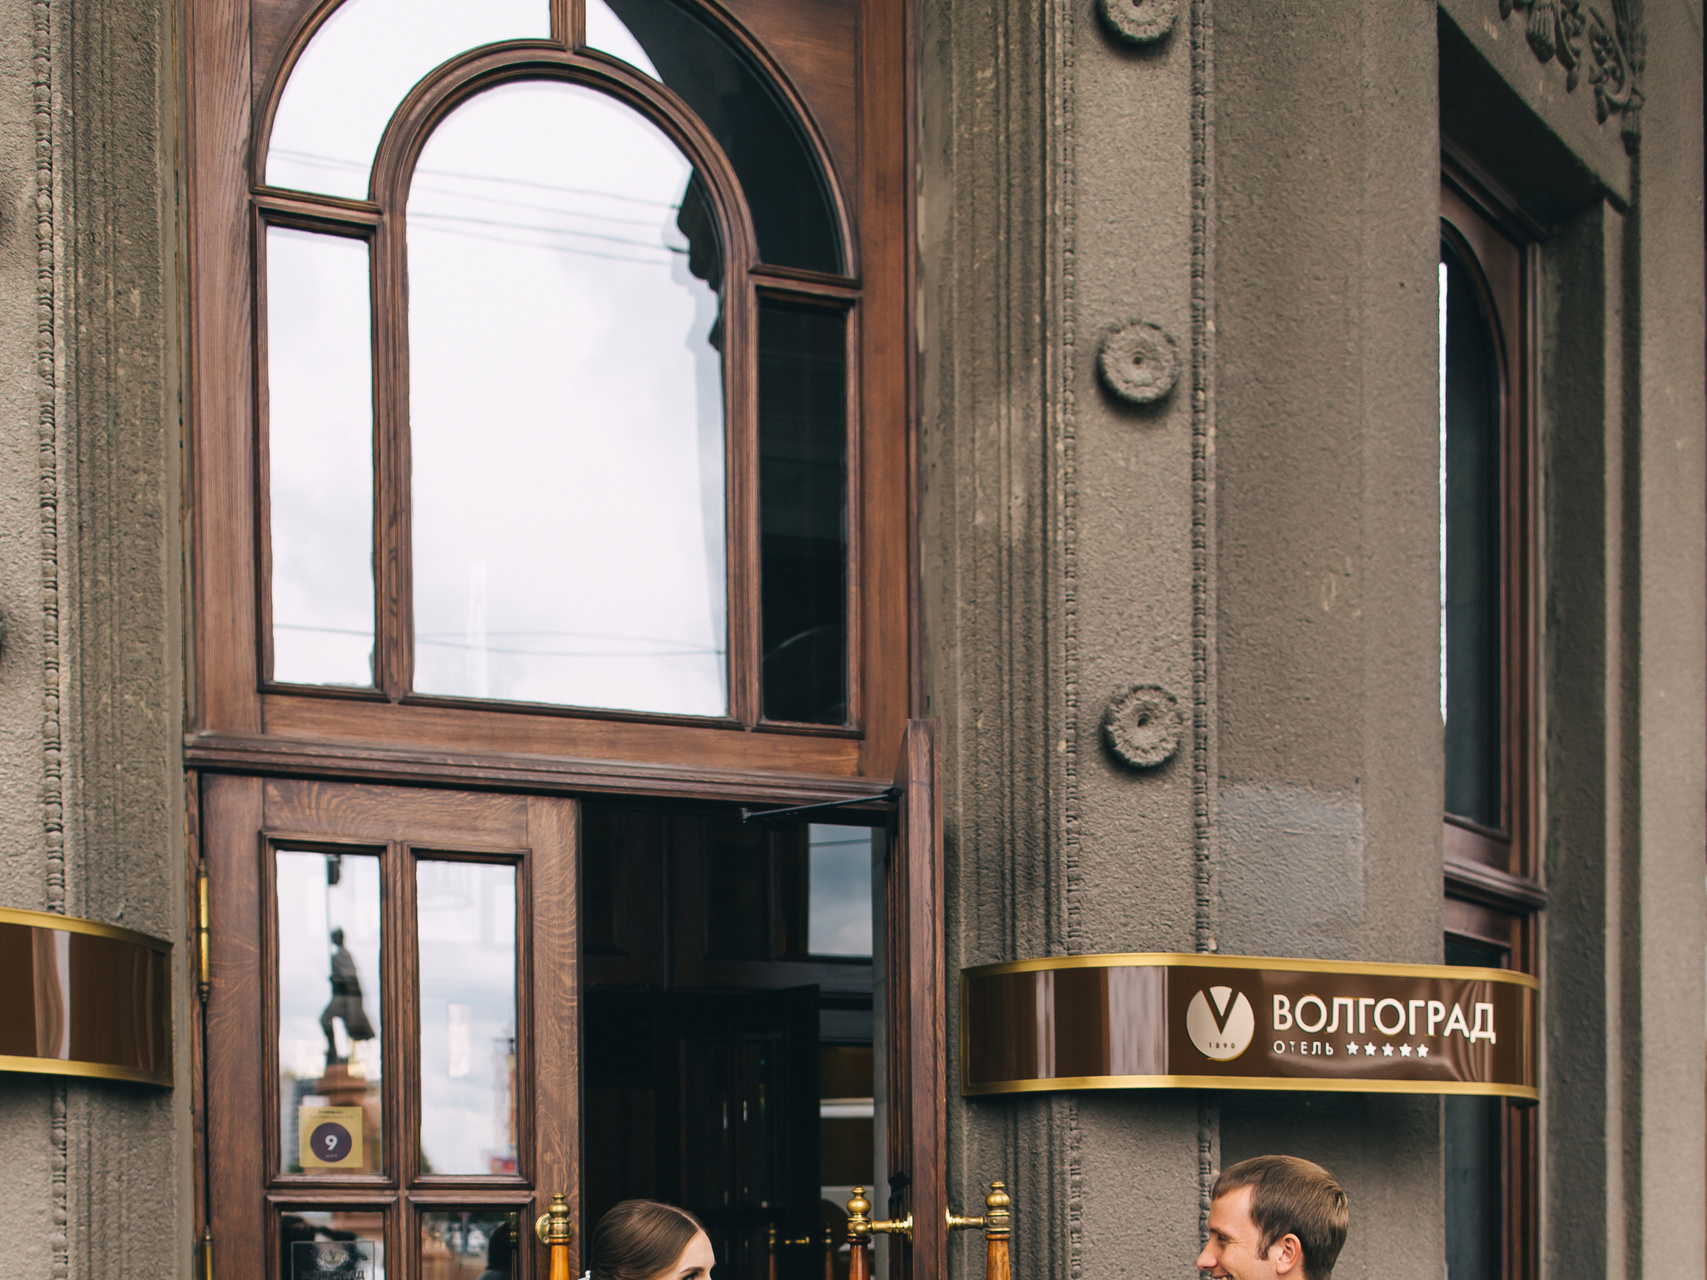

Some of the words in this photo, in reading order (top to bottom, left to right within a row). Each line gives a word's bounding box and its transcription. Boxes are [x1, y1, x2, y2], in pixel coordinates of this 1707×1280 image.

[1273, 994, 1496, 1045] ВОЛГОГРАД
[1273, 1040, 1334, 1056] ОТЕЛЬ
[324, 1135, 338, 1151] 9
